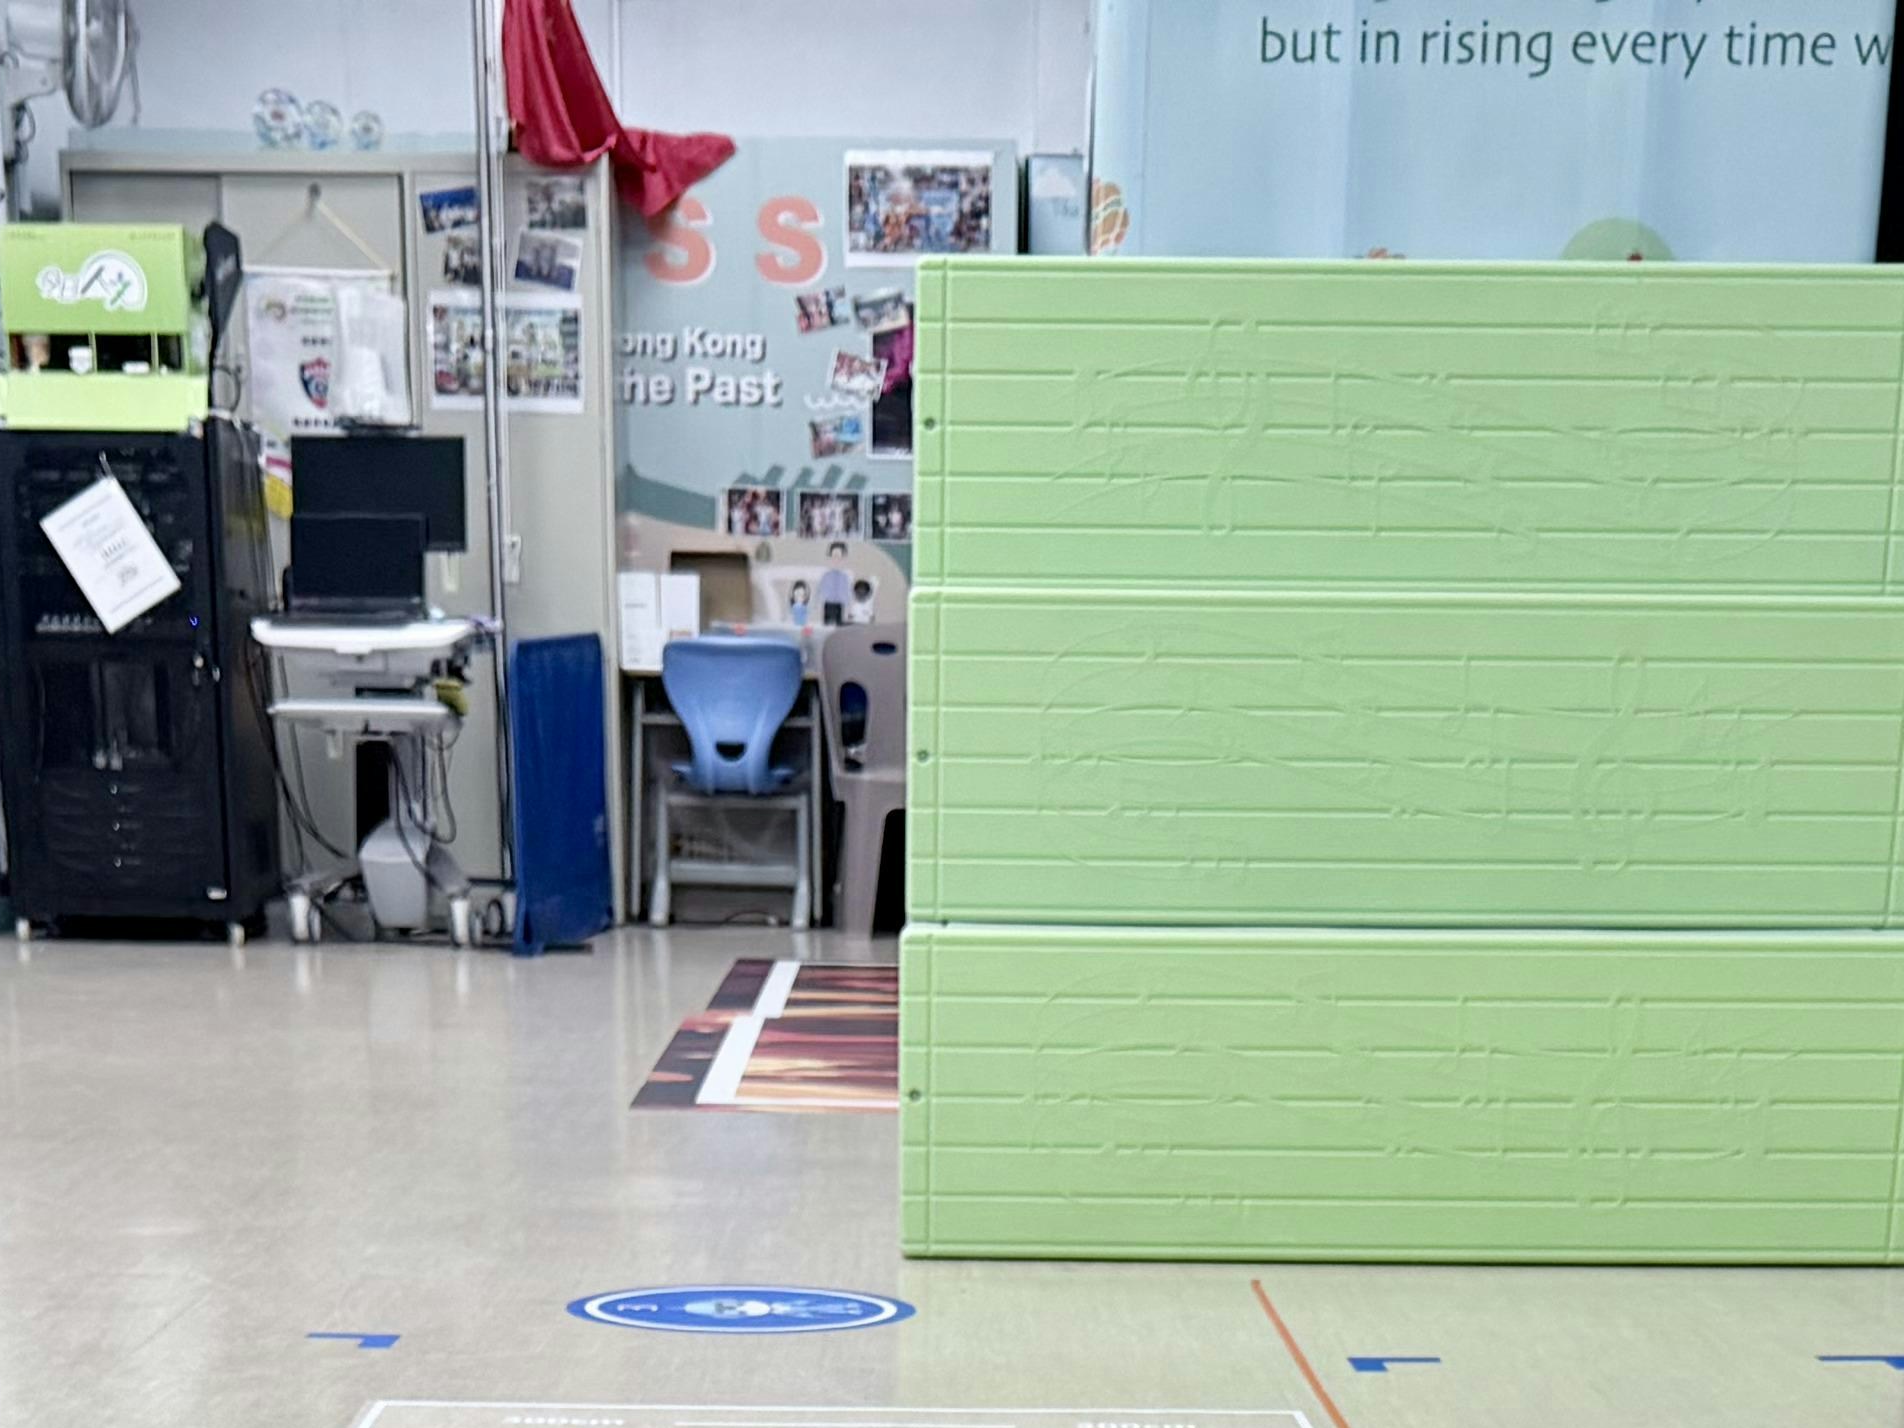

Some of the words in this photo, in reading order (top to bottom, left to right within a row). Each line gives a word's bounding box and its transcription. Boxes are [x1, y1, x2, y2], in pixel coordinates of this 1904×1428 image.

[1259, 18, 1342, 64] but
[1359, 21, 1400, 63] in
[1421, 20, 1554, 77] rising
[1571, 29, 1708, 78] every
[1725, 22, 1837, 66] time
[684, 327, 766, 362] Kong
[686, 366, 783, 406] Past
